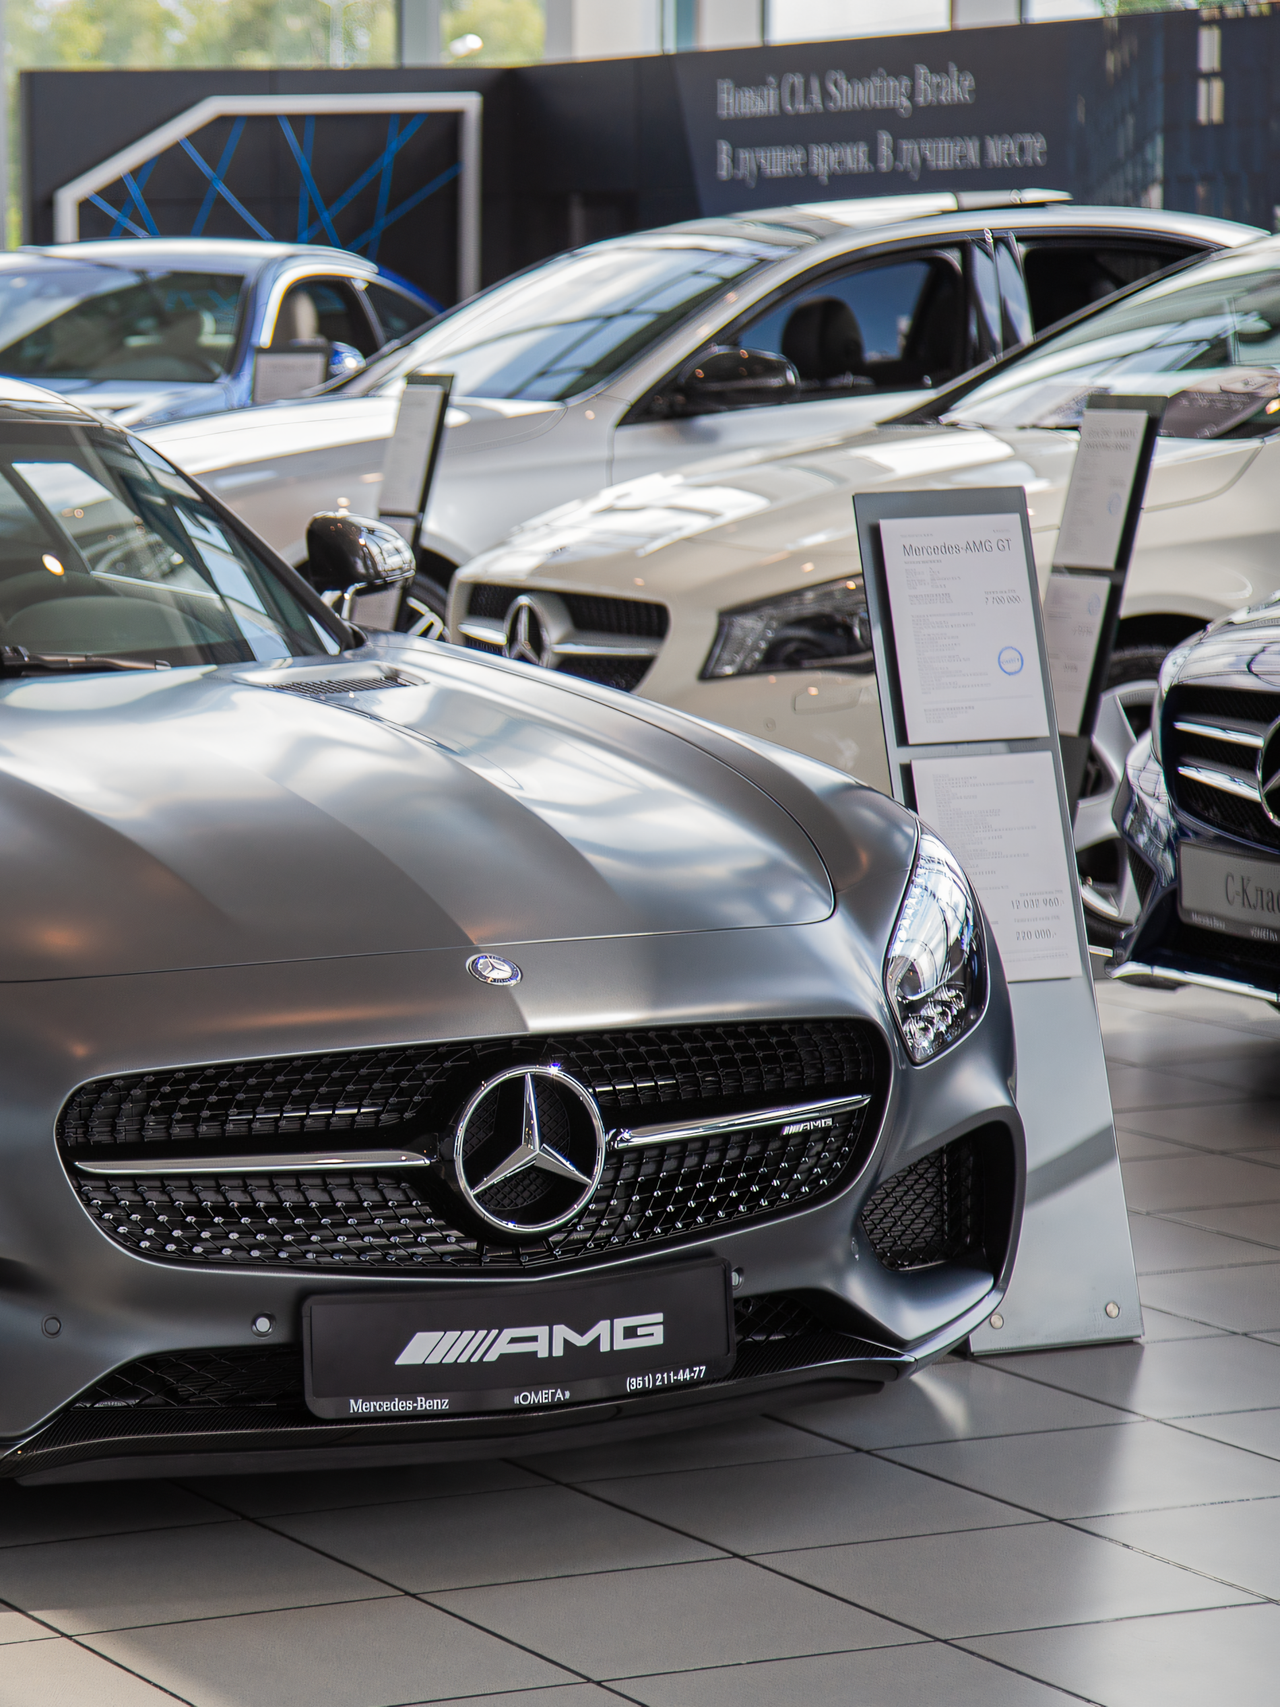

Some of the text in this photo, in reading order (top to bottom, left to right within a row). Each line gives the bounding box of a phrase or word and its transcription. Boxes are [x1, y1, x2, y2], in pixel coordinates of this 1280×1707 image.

[914, 61, 976, 107] Brake
[902, 538, 1011, 557] Mercedes-AMG GT
[799, 1118, 832, 1131] AMG
[483, 1312, 664, 1362] AMG
[655, 1365, 706, 1386] 211-44-77
[349, 1396, 449, 1413] Mercedes-Benz
[513, 1388, 570, 1405] «ОМЕГА»
